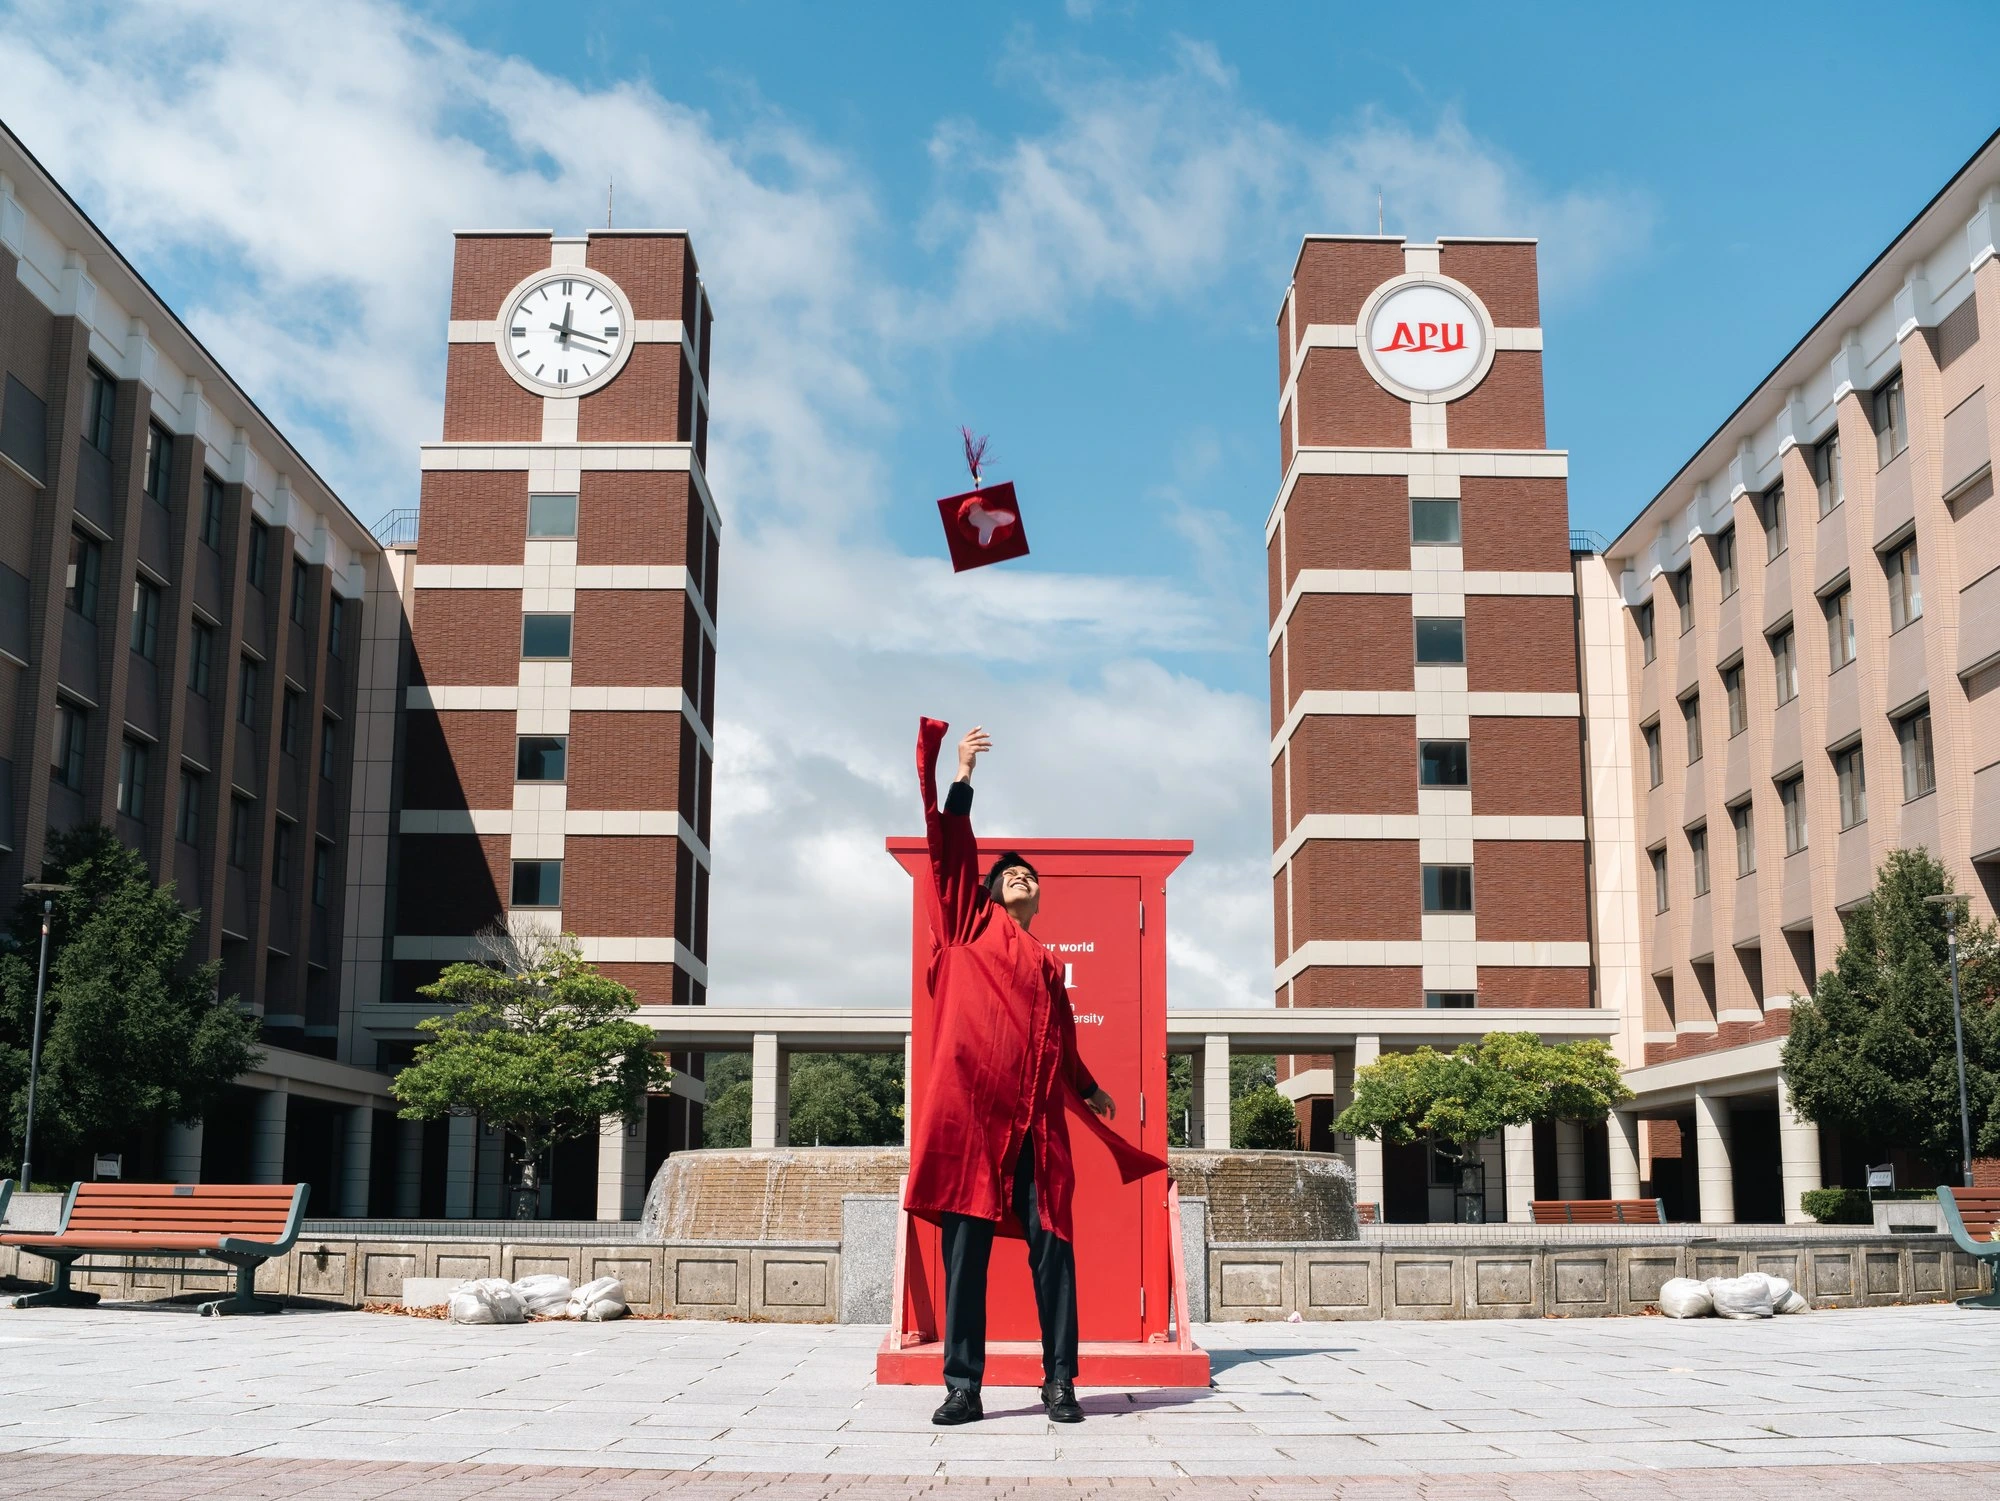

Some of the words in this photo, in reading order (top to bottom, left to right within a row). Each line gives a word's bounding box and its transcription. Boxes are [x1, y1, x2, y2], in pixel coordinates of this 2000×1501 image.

[1375, 322, 1470, 353] APU
[1059, 941, 1095, 952] world
[1073, 1013, 1104, 1026] ersity
